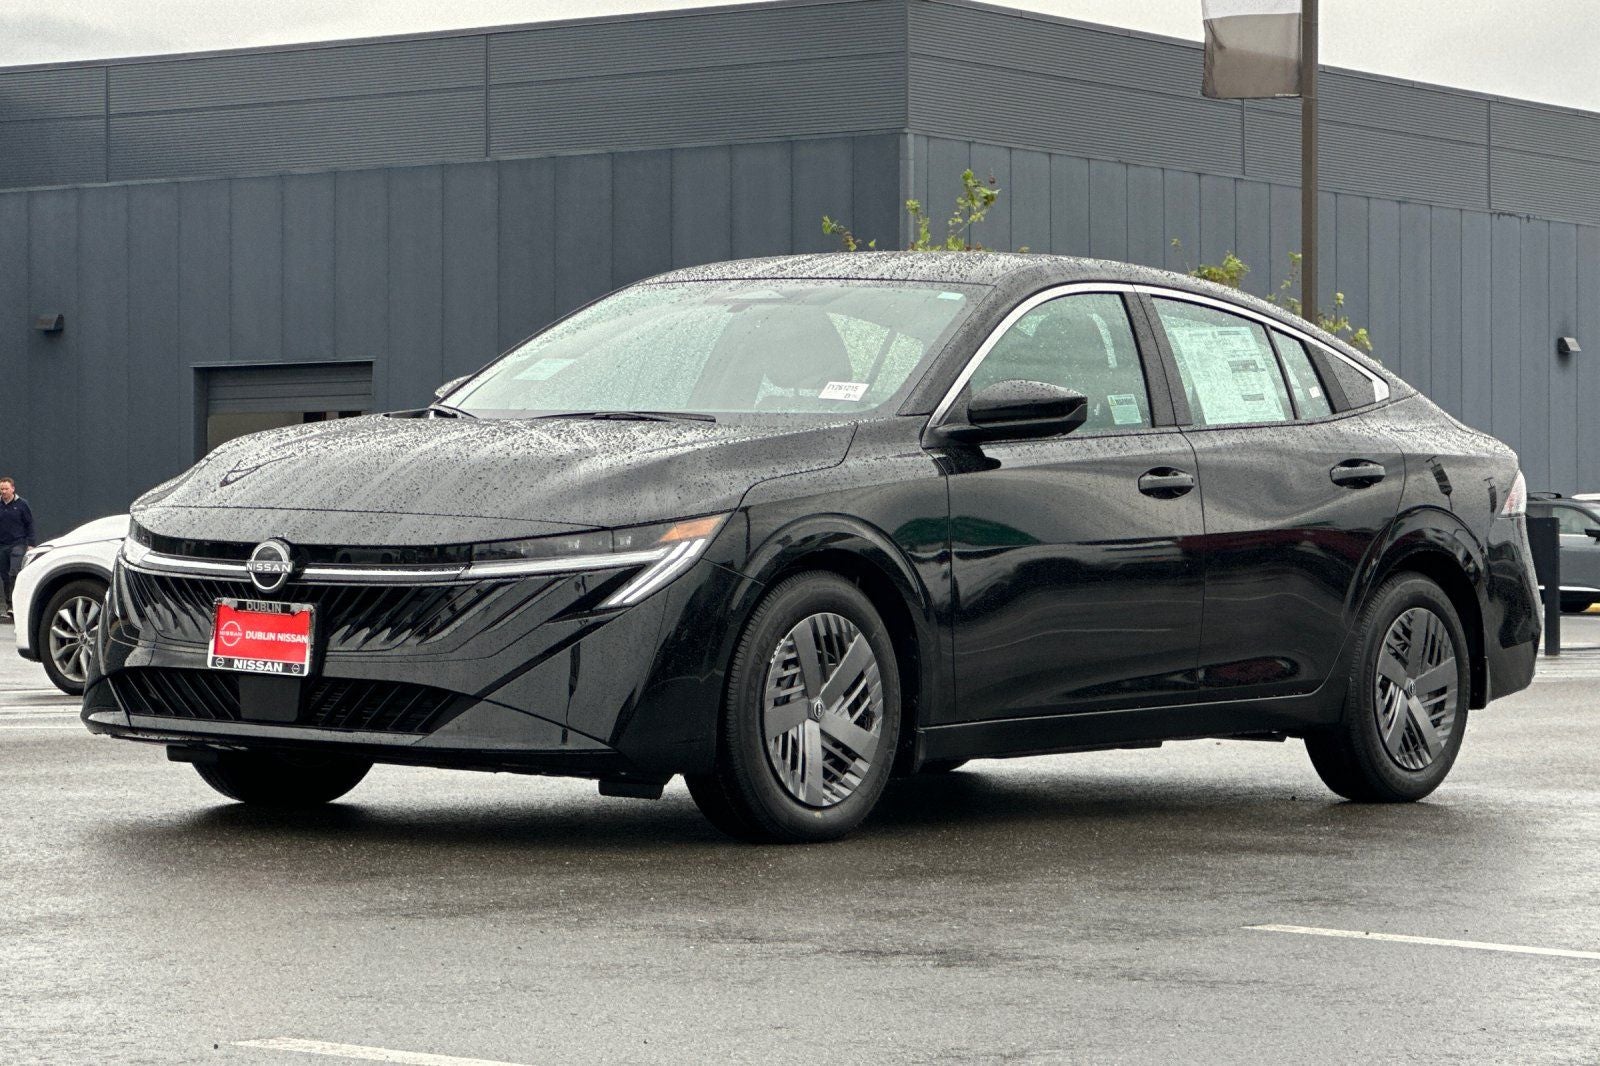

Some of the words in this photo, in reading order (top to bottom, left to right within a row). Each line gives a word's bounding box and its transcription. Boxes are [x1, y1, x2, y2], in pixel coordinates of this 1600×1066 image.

[246, 563, 292, 573] NISSAN
[246, 601, 281, 613] DUBLIN
[246, 630, 276, 641] DUBLIN
[277, 633, 309, 643] NISSAN
[233, 659, 283, 672] NISSAN
